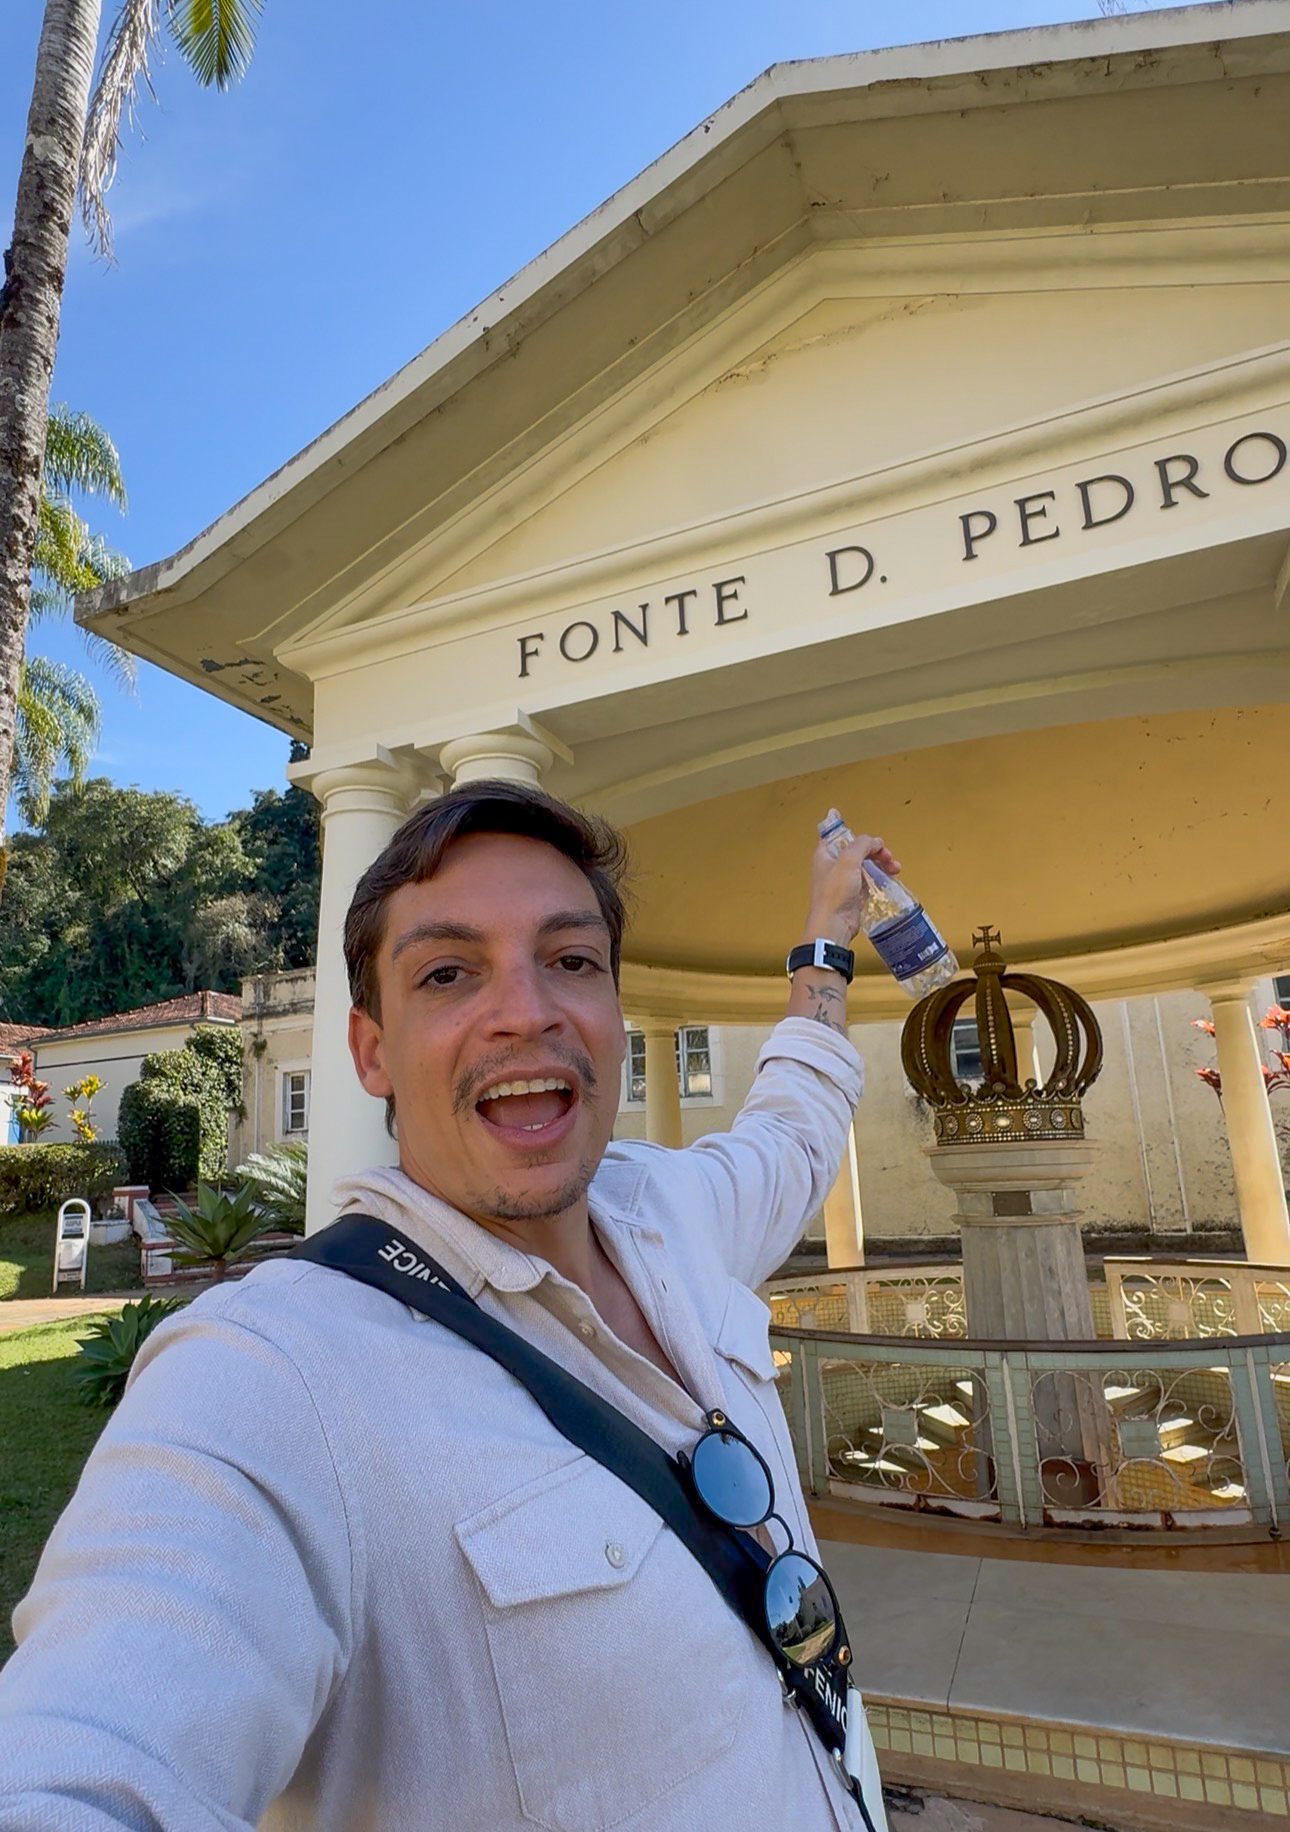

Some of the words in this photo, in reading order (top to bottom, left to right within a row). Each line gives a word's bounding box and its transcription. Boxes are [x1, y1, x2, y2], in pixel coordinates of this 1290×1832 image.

[517, 575, 748, 678] FONTE
[825, 545, 888, 596] D.
[958, 432, 1288, 562] PEDRO
[377, 1238, 451, 1293] NICE
